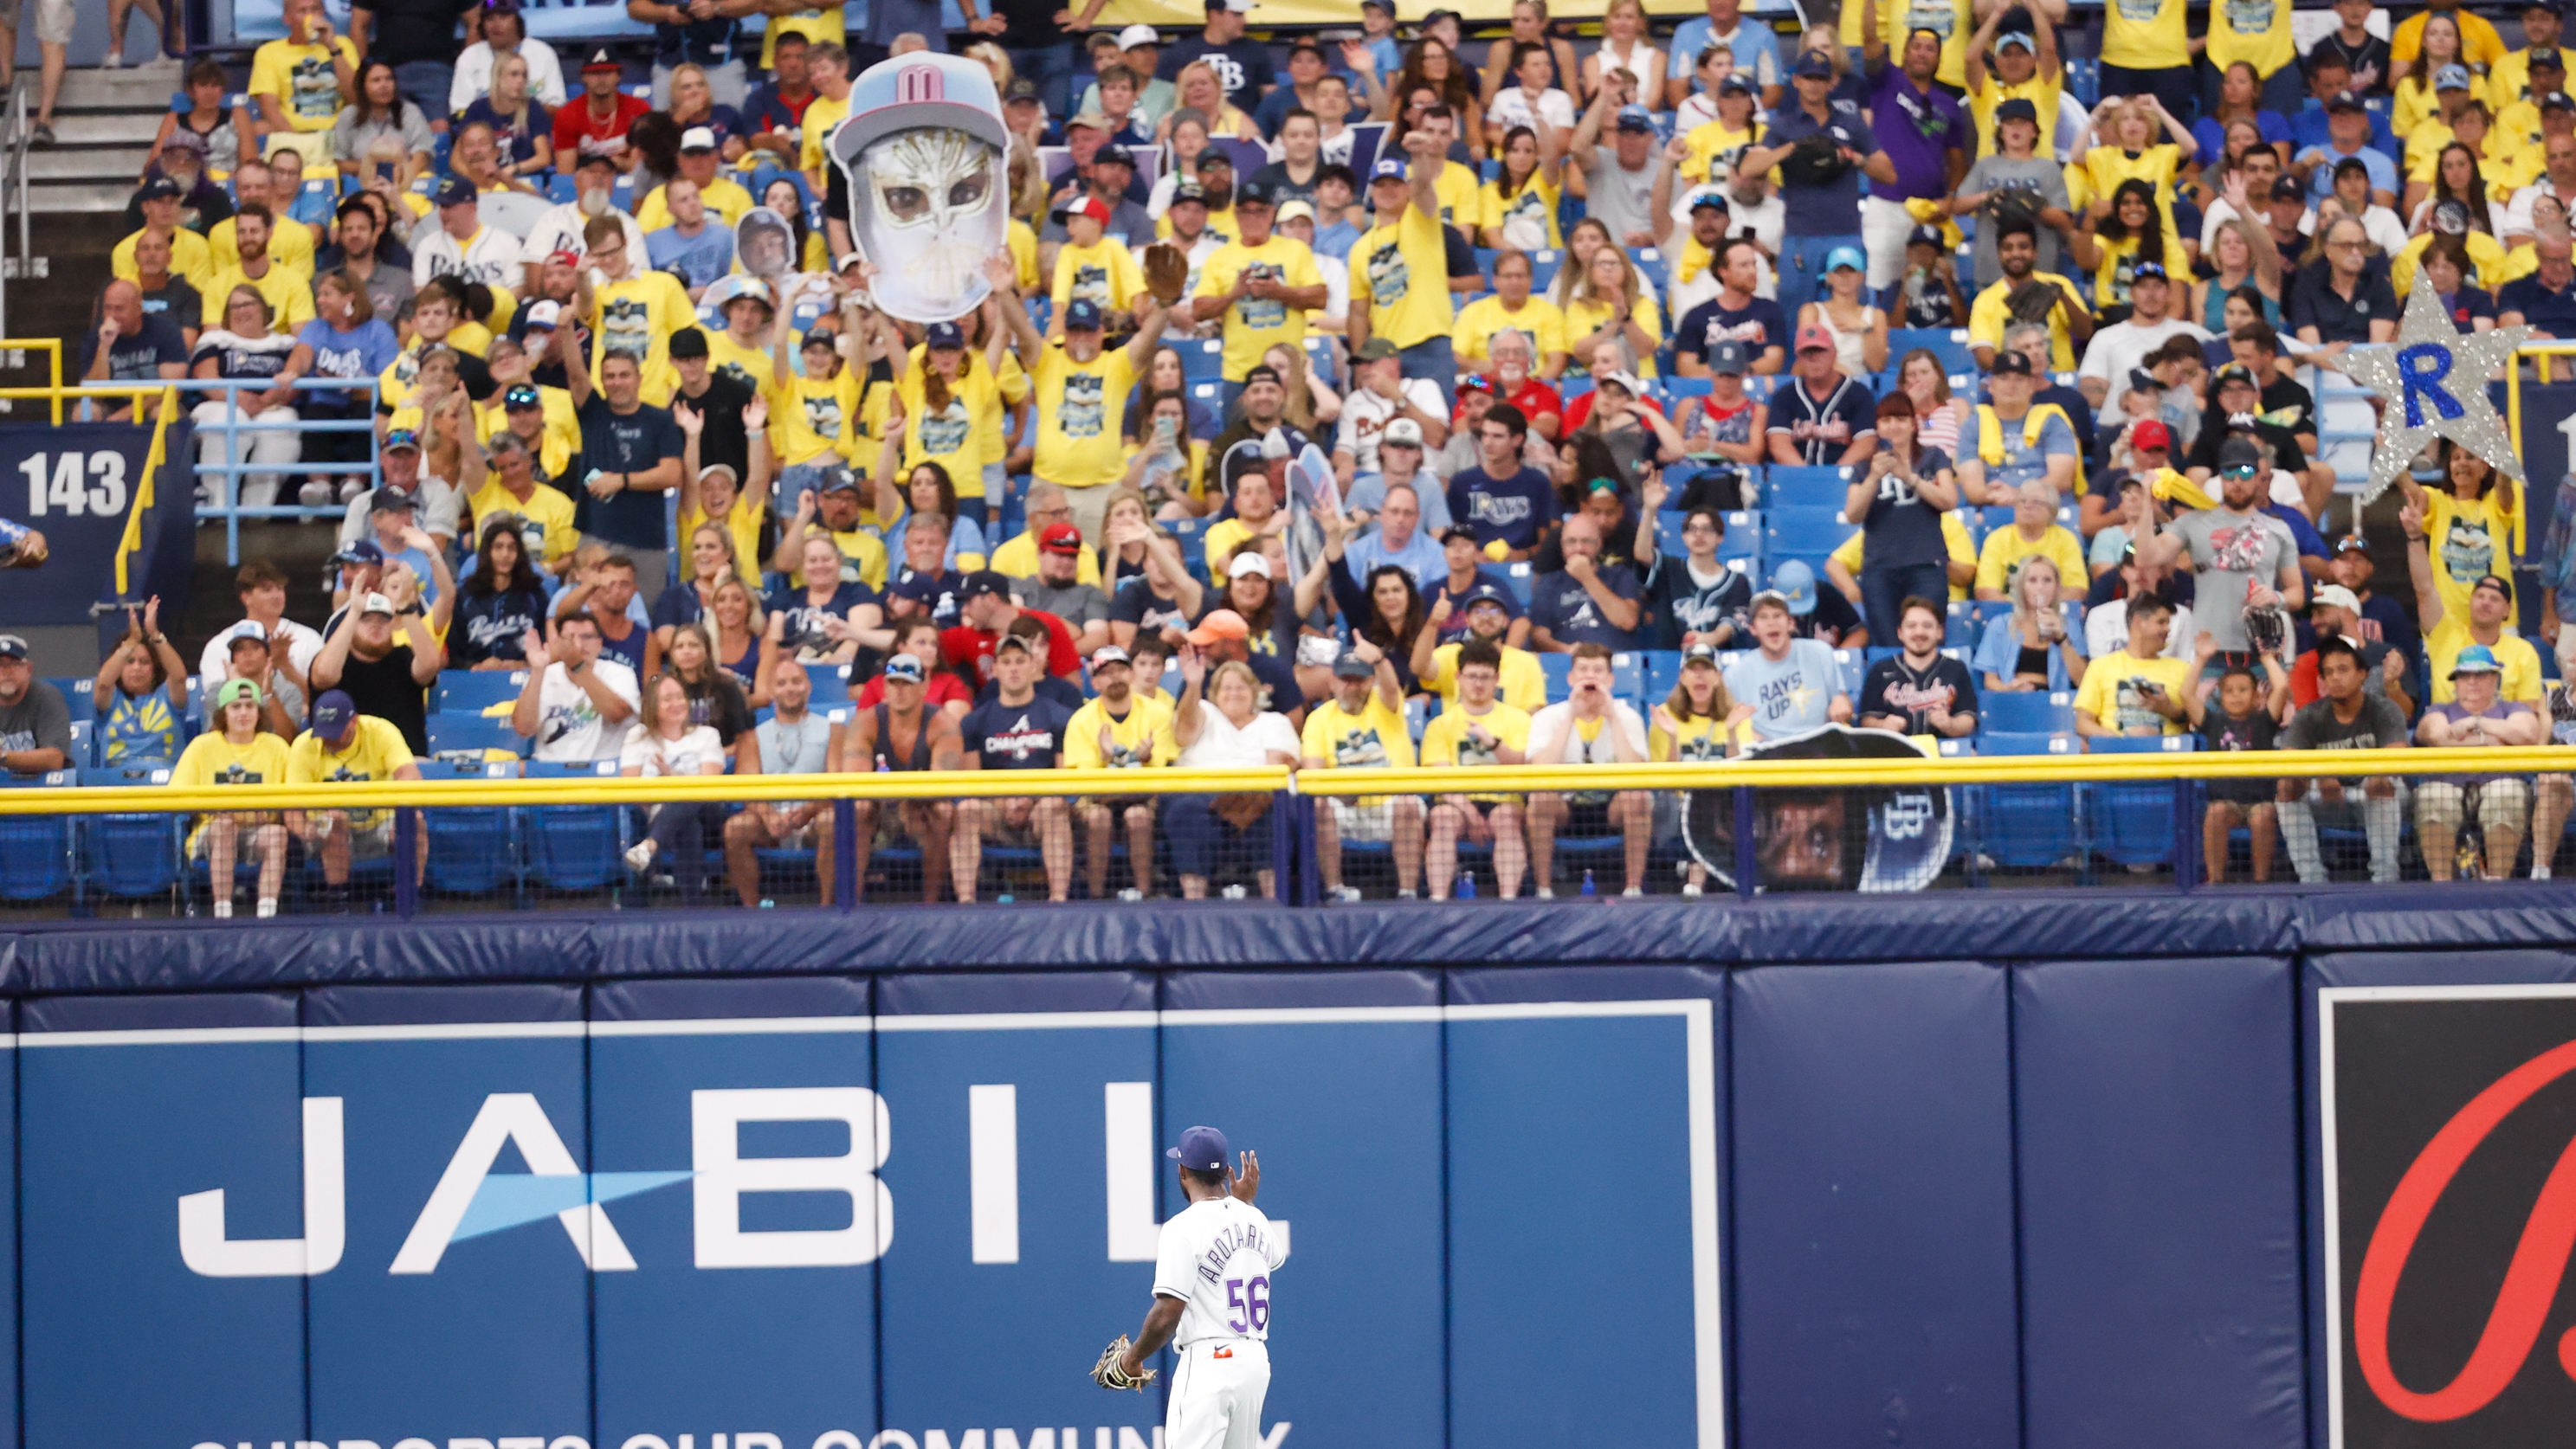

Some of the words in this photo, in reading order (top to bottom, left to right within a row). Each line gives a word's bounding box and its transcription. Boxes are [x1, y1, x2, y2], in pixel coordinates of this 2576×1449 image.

[1199, 53, 1245, 90] TB
[2397, 342, 2464, 428] R
[18, 450, 126, 517] 143
[1759, 673, 1802, 703] RAYS
[1010, 715, 1030, 734] A
[1768, 698, 1792, 720] UP
[985, 732, 1054, 753] CHAMPIONS
[178, 1082, 1291, 1276] JABIL
[1224, 1273, 1270, 1334] 56
